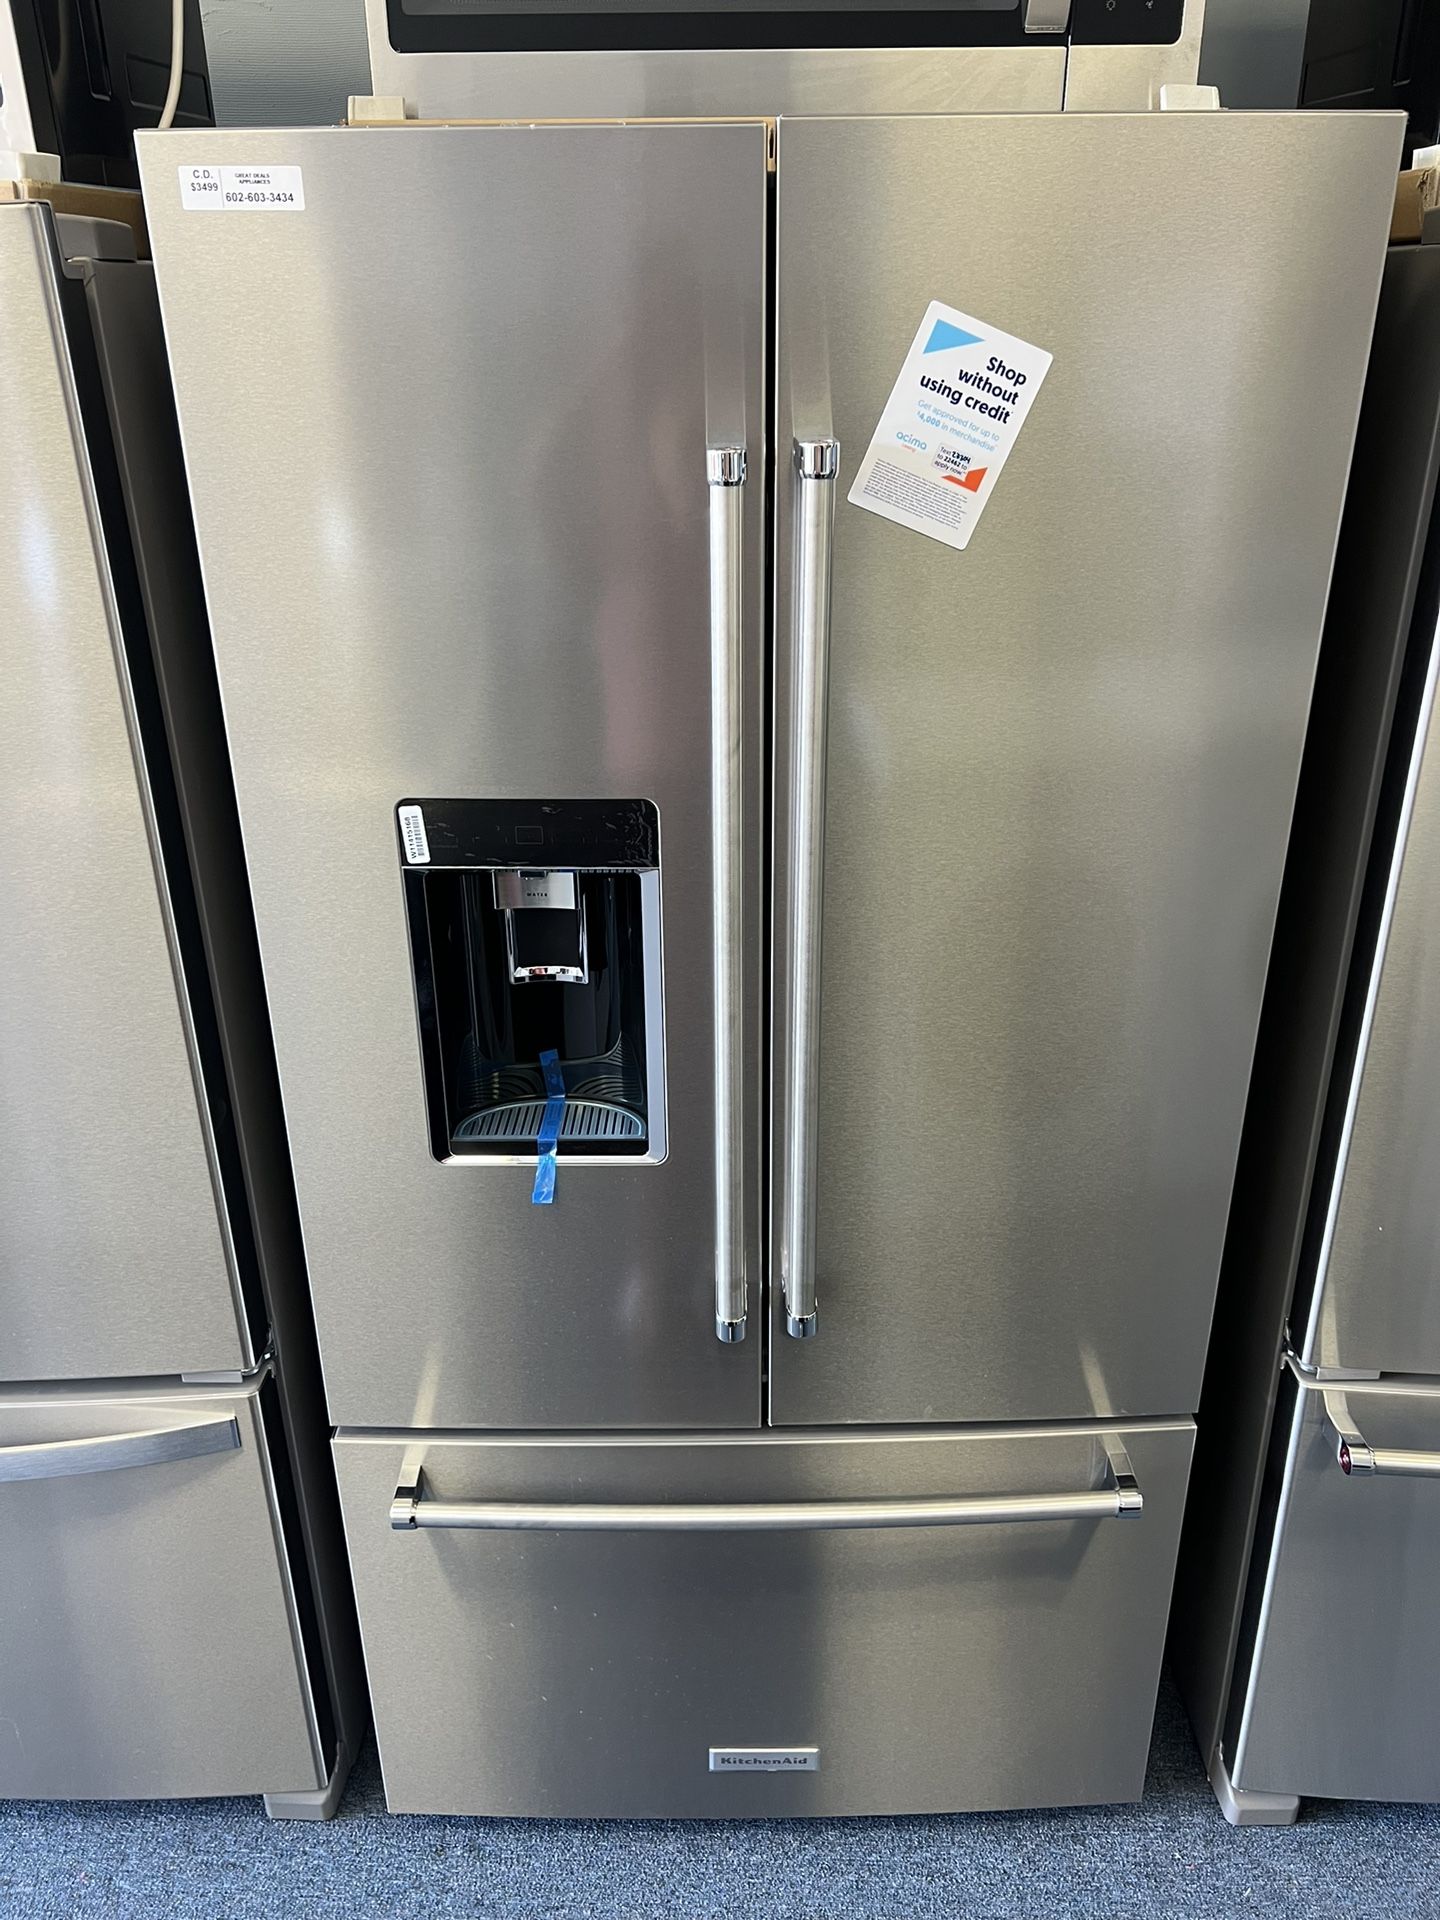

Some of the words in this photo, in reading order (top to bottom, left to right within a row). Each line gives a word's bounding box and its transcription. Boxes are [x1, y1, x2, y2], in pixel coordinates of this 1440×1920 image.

[193, 170, 214, 179] C.D.
[190, 182, 219, 192] $3499
[225, 192, 294, 203] 602-603-3434
[986, 356, 1027, 387] Shop
[920, 375, 963, 405] using
[958, 369, 1019, 405] without
[918, 400, 932, 411] Get
[932, 406, 968, 427] approved
[969, 422, 980, 432] for
[980, 428, 991, 438] up
[991, 432, 1000, 441] to
[941, 422, 949, 431] in
[896, 431, 927, 450] acima
[720, 1757, 808, 1765] KitchenAid
